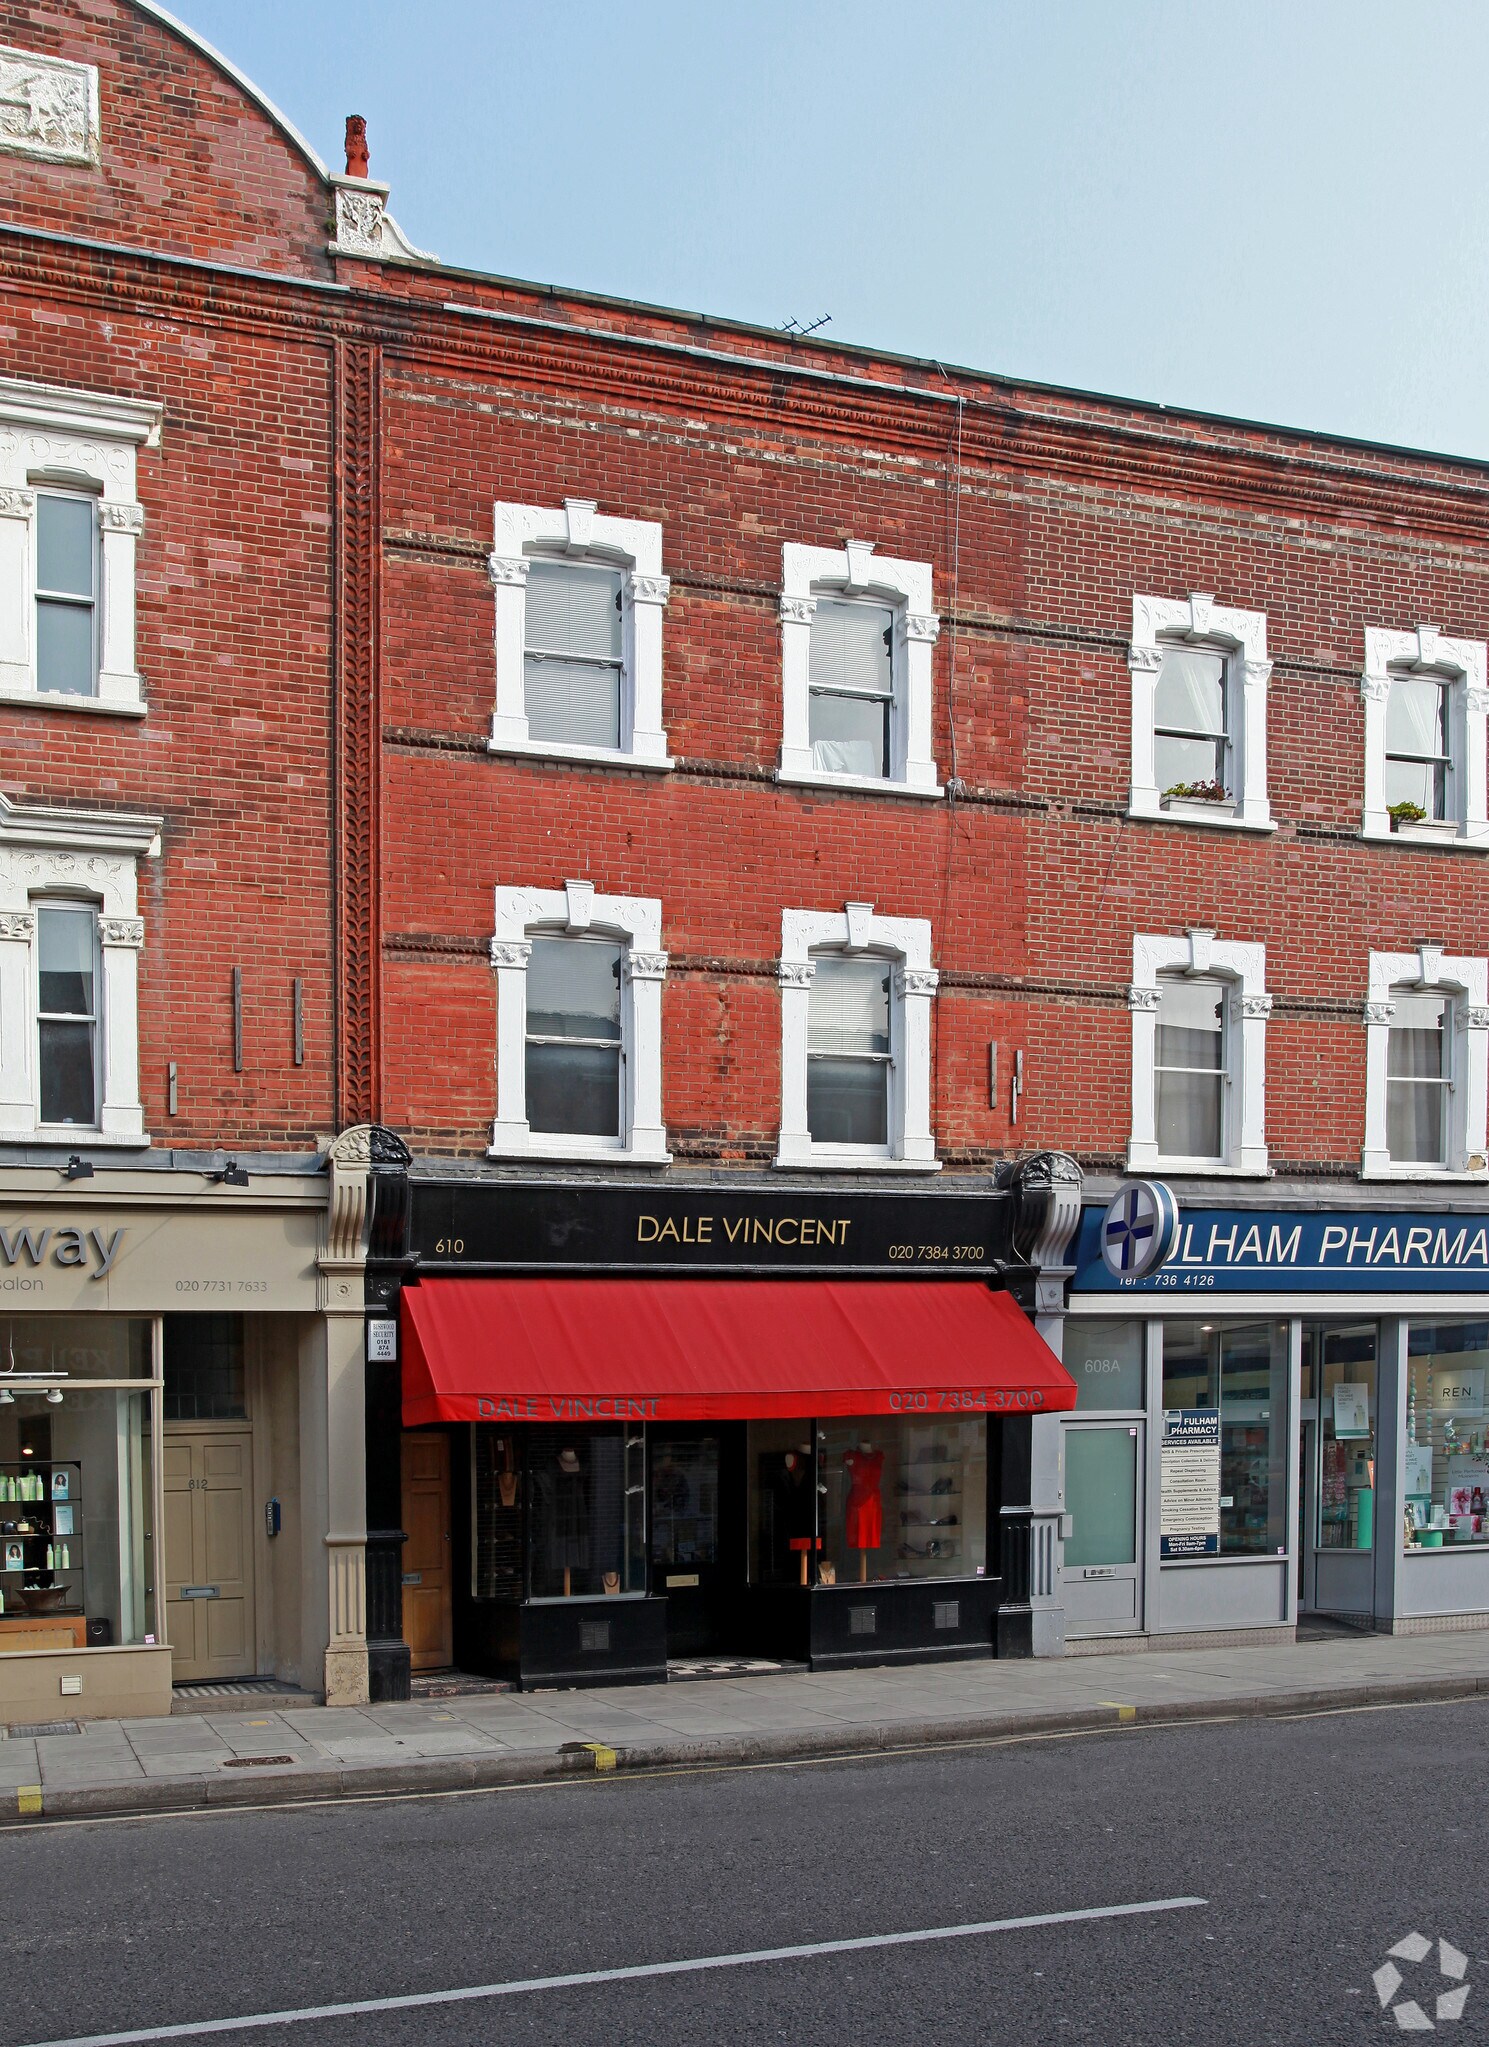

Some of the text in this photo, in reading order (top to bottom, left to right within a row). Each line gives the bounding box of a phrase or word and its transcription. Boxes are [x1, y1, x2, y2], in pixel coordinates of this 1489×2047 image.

[637, 1215, 851, 1245] DALE VINCENT
[0, 1226, 125, 1279] way
[435, 1239, 464, 1254] 610
[888, 1245, 984, 1260] 020 7384 3700
[1319, 1226, 1489, 1264] PHARMA
[0, 1276, 44, 1291] alon
[175, 1280, 267, 1292] 020 7731 7633
[1154, 1275, 1178, 1286] 736
[1183, 1275, 1215, 1286] 4126
[1085, 1359, 1121, 1373] 608A
[889, 1389, 1045, 1410] 020 7384 3700
[1442, 1387, 1472, 1397] REN
[477, 1398, 660, 1417] DALE VINCENT
[1184, 1417, 1218, 1425] FULHAM
[1171, 1426, 1217, 1435] PHARMACY
[189, 1479, 208, 1489] 612
